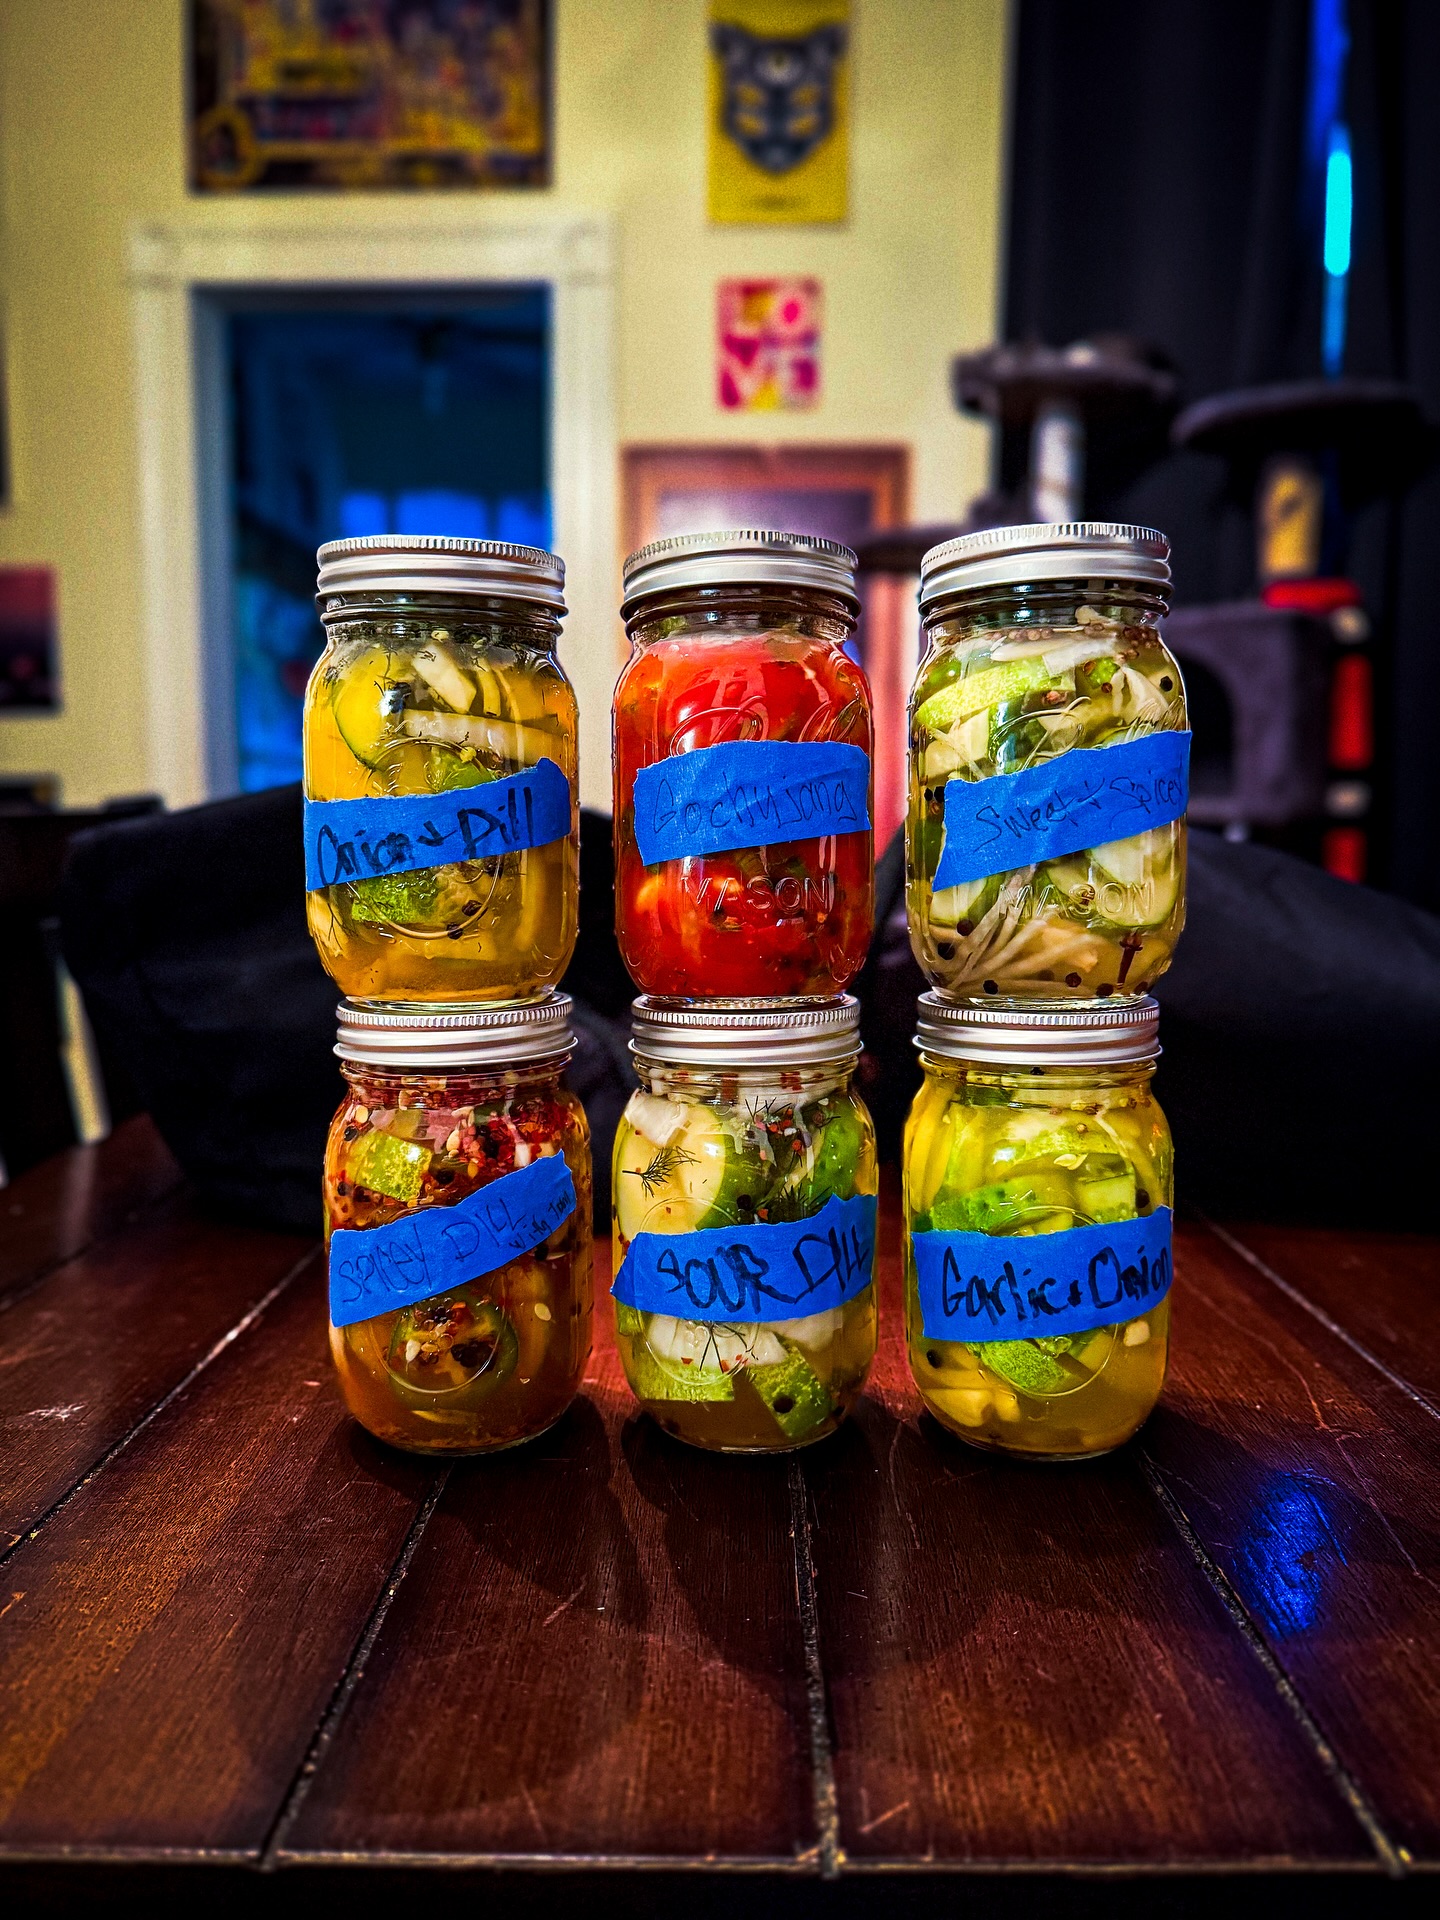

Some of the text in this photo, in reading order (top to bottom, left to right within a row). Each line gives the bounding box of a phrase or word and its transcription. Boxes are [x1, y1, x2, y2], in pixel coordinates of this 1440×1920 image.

[317, 823, 415, 886] Onion
[456, 786, 534, 859] Dill
[680, 873, 834, 915] MASON
[441, 1198, 527, 1262] DILL
[656, 1242, 797, 1315] SOUR
[942, 1245, 1068, 1326] Garlic
[1088, 1245, 1171, 1309] Onion
